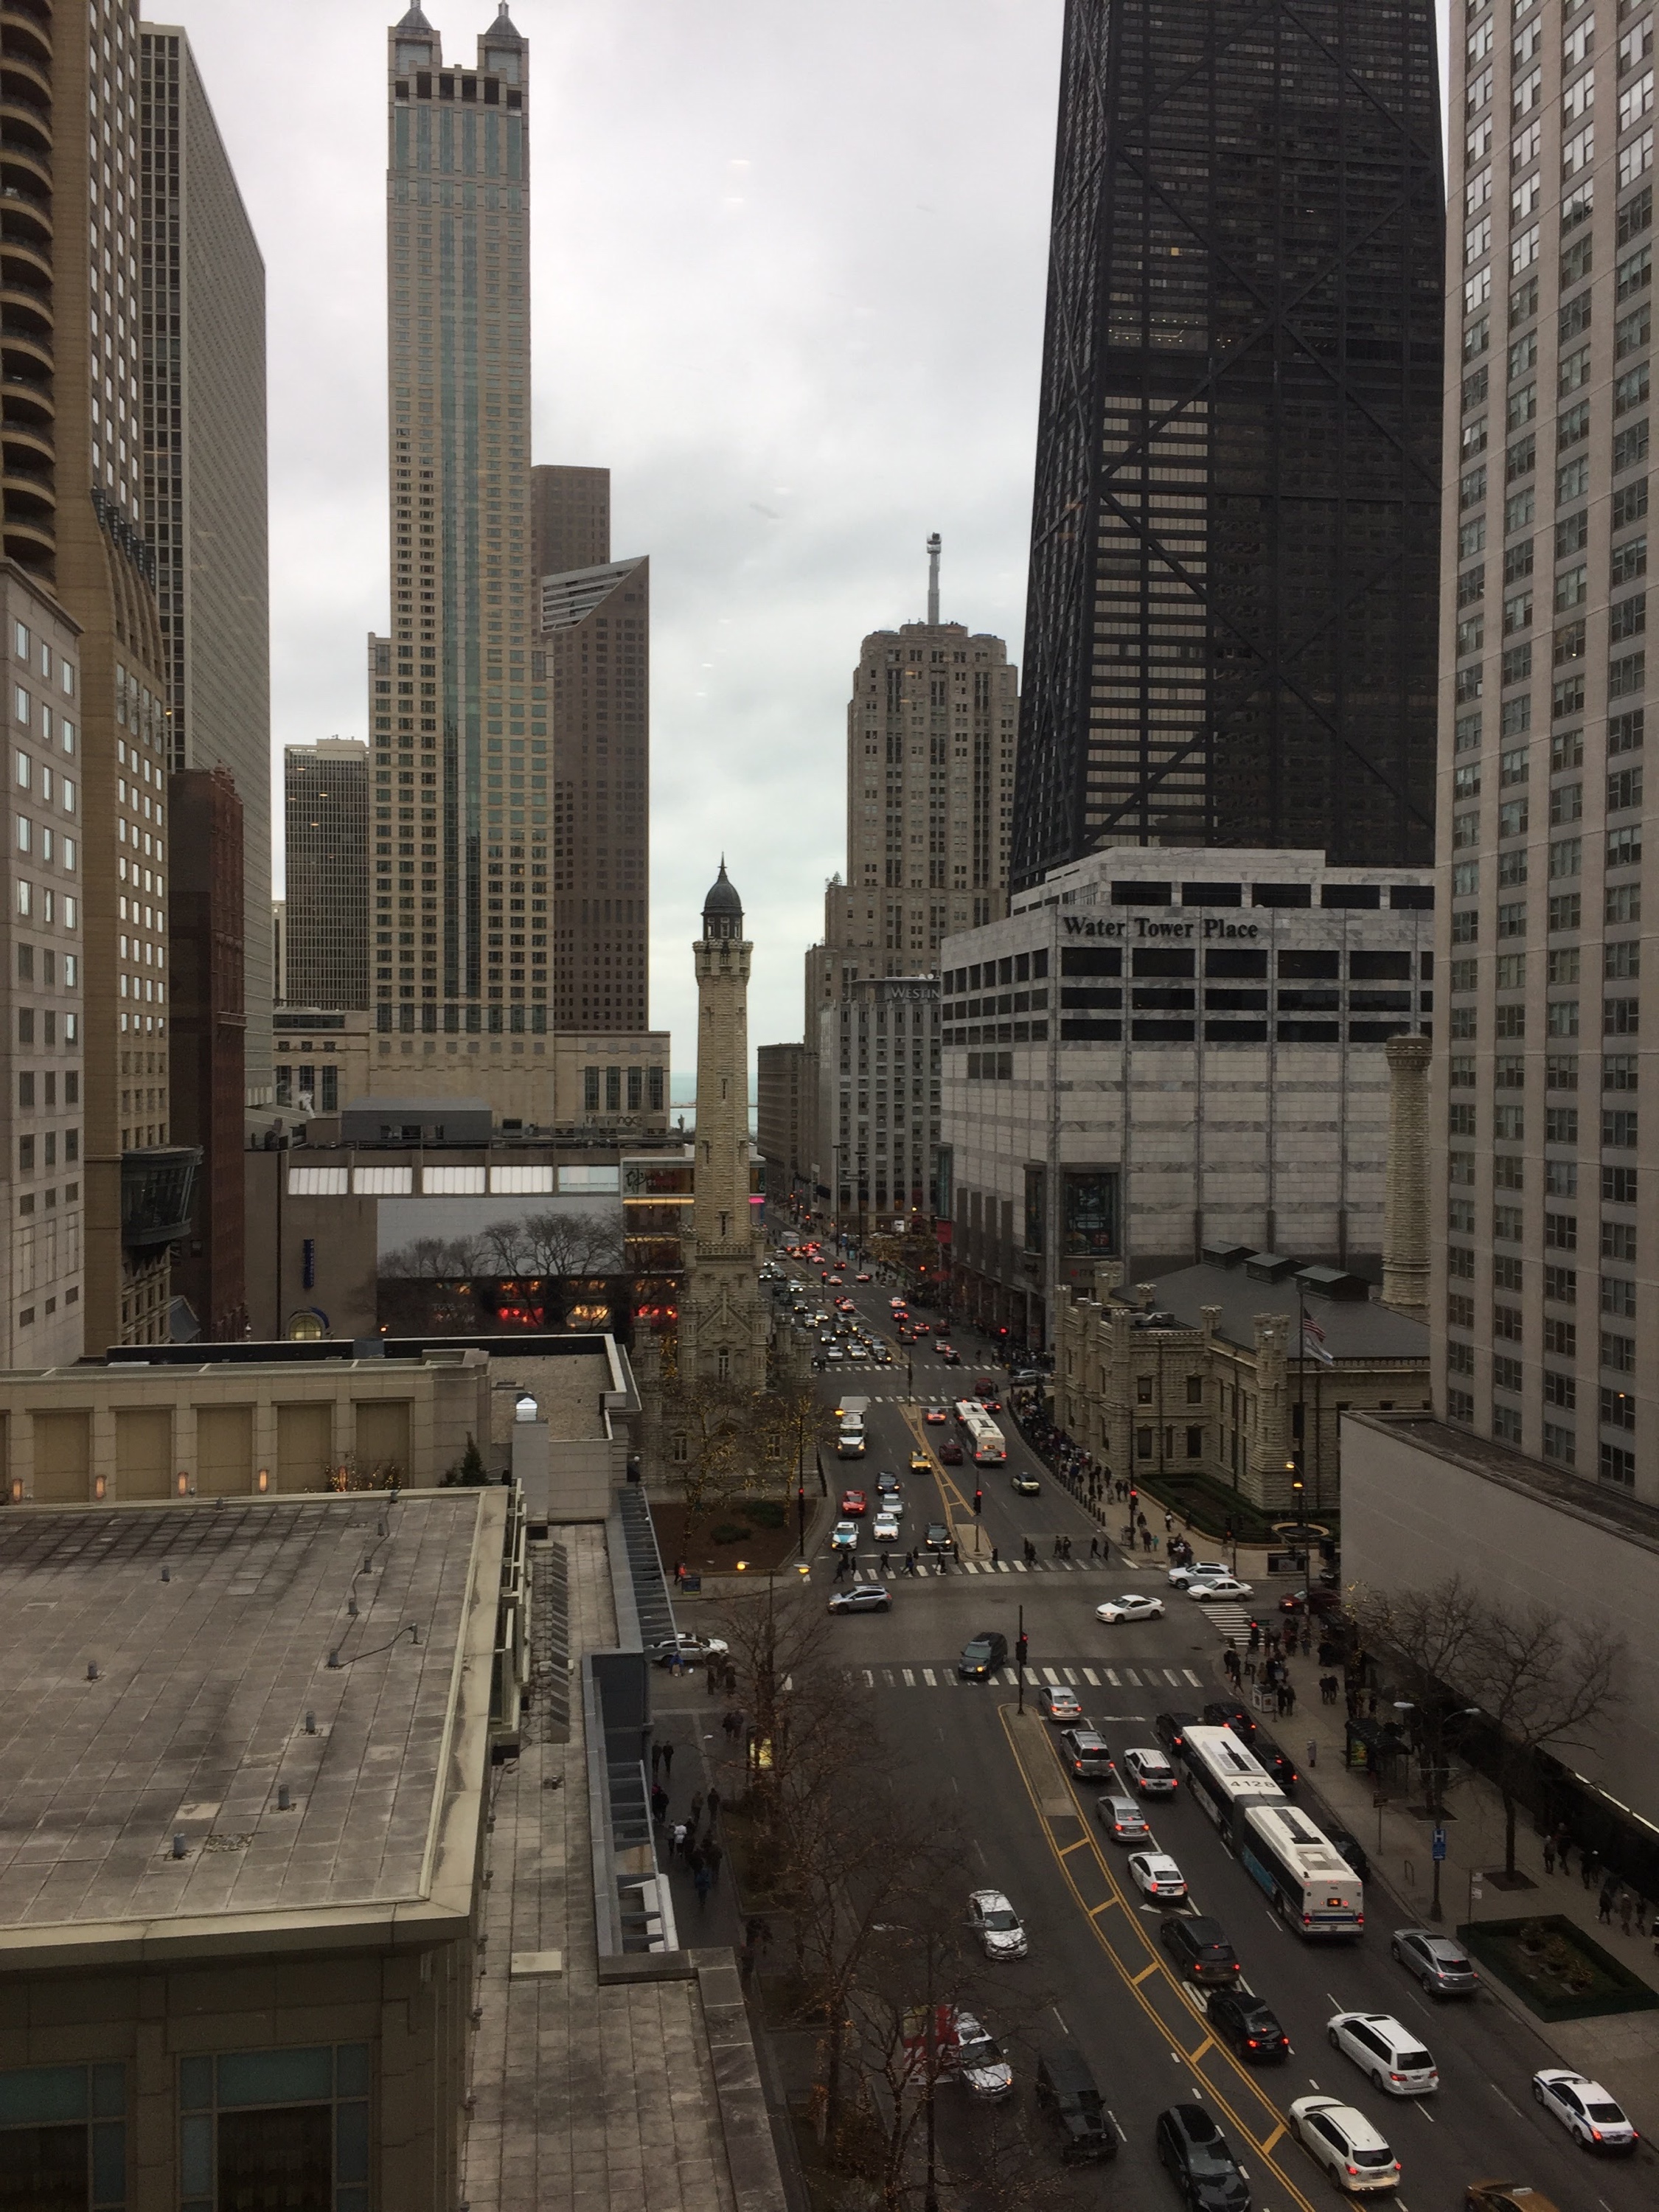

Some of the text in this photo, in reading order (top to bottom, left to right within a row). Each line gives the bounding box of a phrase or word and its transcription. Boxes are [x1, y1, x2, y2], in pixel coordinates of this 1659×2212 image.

[1063, 917, 1259, 939] Water Tower Place
[1230, 1780, 1276, 1788] 4128
[1434, 1830, 1444, 1843] H
